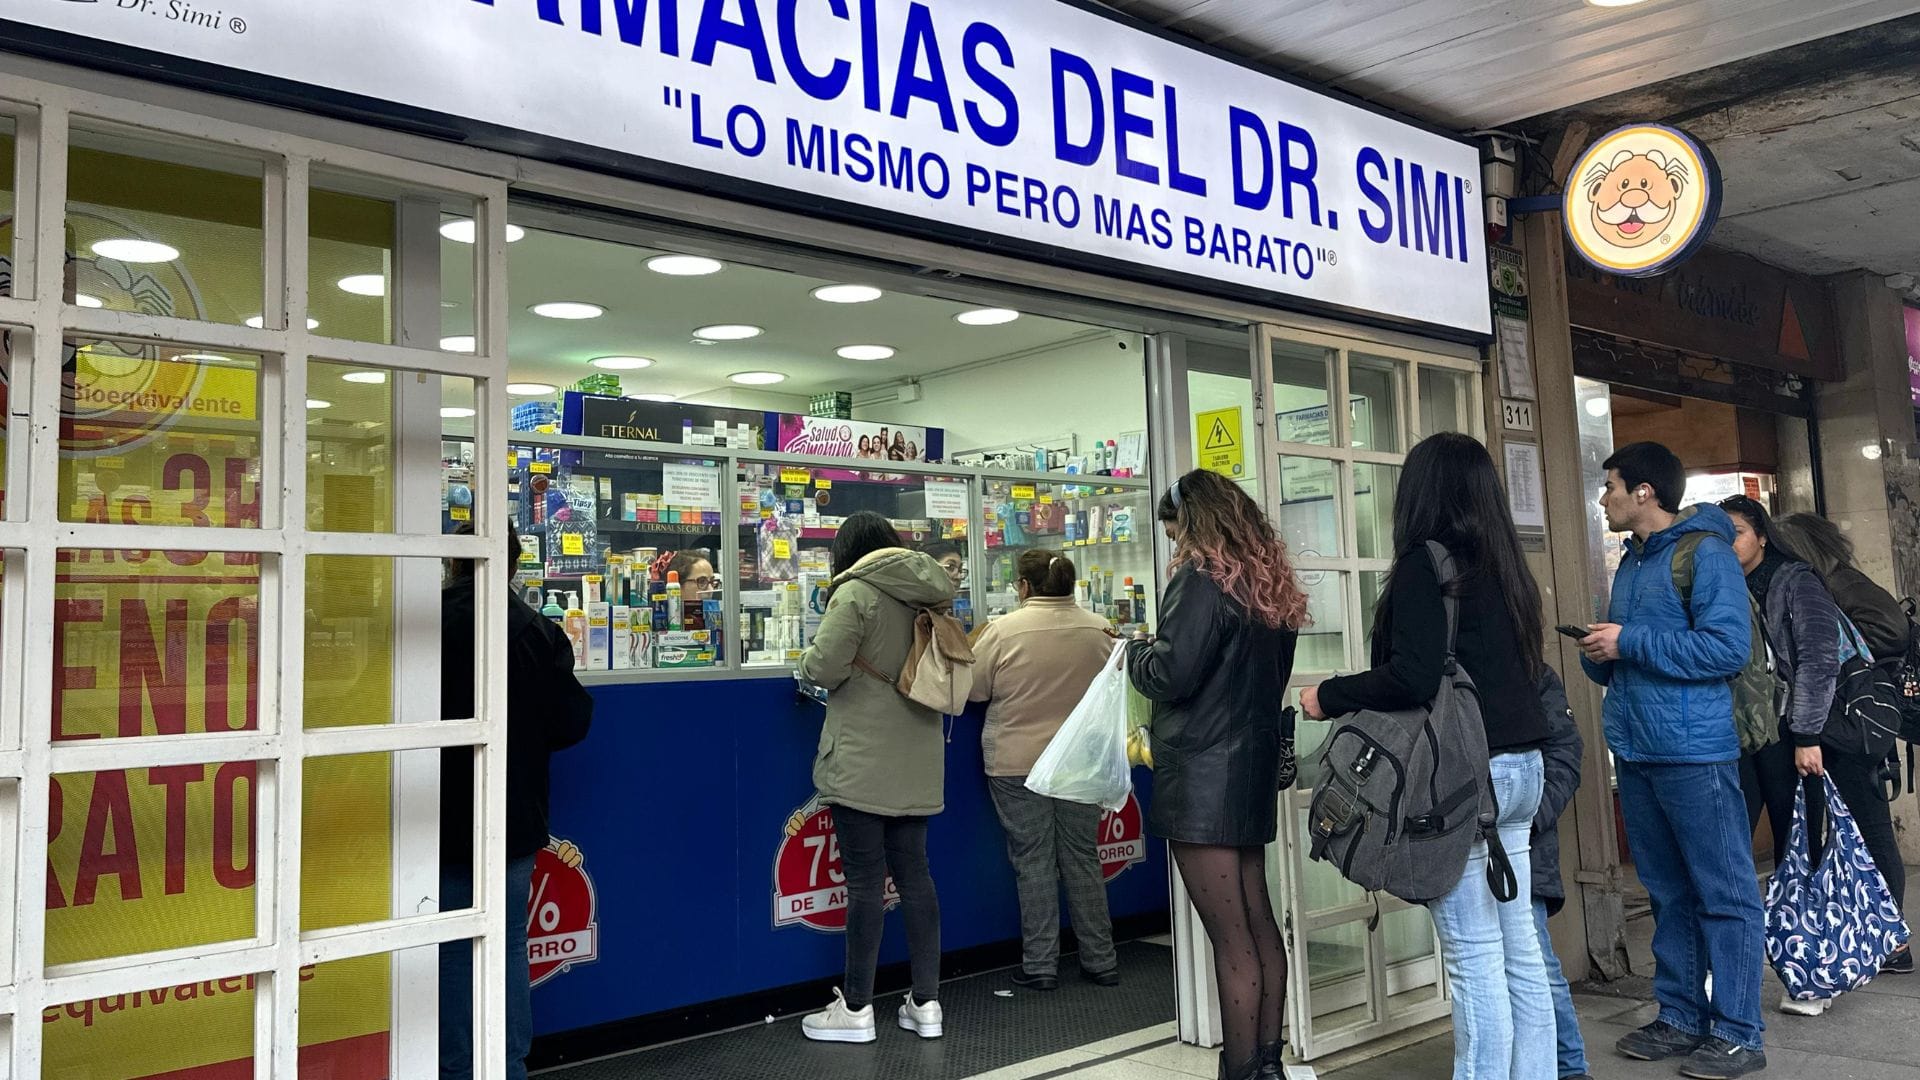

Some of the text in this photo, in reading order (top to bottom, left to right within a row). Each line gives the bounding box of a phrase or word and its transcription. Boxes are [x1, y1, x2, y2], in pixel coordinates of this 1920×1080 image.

[165, 0, 222, 29] Simi
[1050, 47, 1207, 197] DEL
[1229, 105, 1338, 231] DR.
[786, 118, 950, 200] MISMO
[966, 162, 1081, 229] PERO
[1094, 195, 1173, 249] MAS
[1506, 405, 1530, 426] 311
[601, 424, 661, 440] ETERNAL
[573, 499, 593, 509] Tipsy
[56, 494, 152, 564] AS
[642, 523, 706, 533] ETERNAL SECRET
[803, 833, 847, 888] 75
[1100, 844, 1135, 861] ORRO
[791, 897, 814, 913] DE
